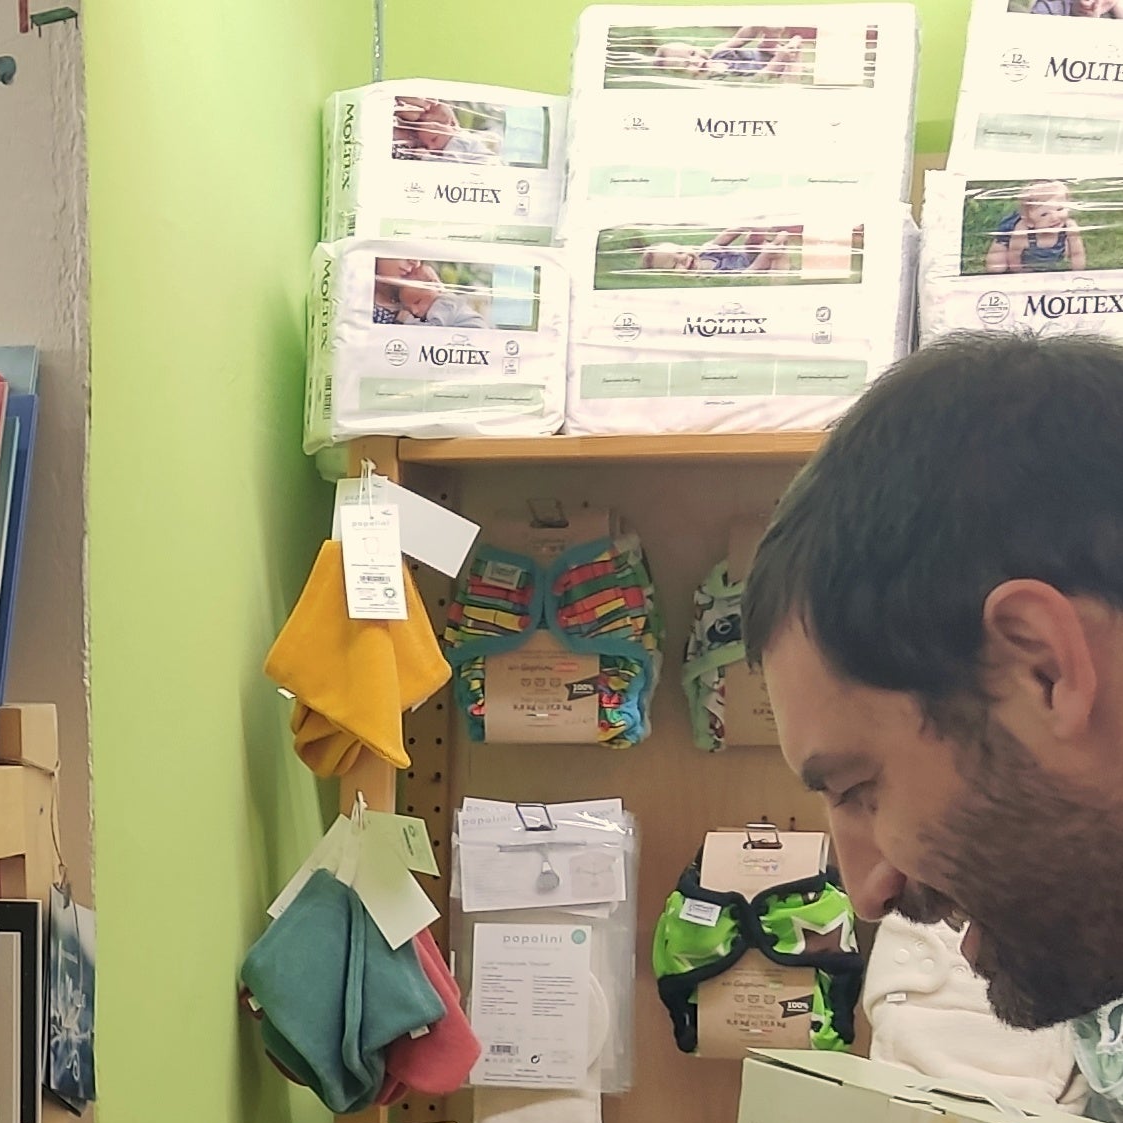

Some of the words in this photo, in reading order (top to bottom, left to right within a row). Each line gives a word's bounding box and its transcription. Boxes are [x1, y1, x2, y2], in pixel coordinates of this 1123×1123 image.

[695, 117, 779, 138] MOLTEX
[434, 184, 502, 204] MOLTEX
[1023, 294, 1123, 319] MOLTEX
[683, 316, 768, 338] MOLTEX
[419, 345, 491, 366] MOLTEX
[573, 683, 594, 694] 100%
[503, 933, 563, 945] popolini
[787, 1001, 809, 1009] 100%
